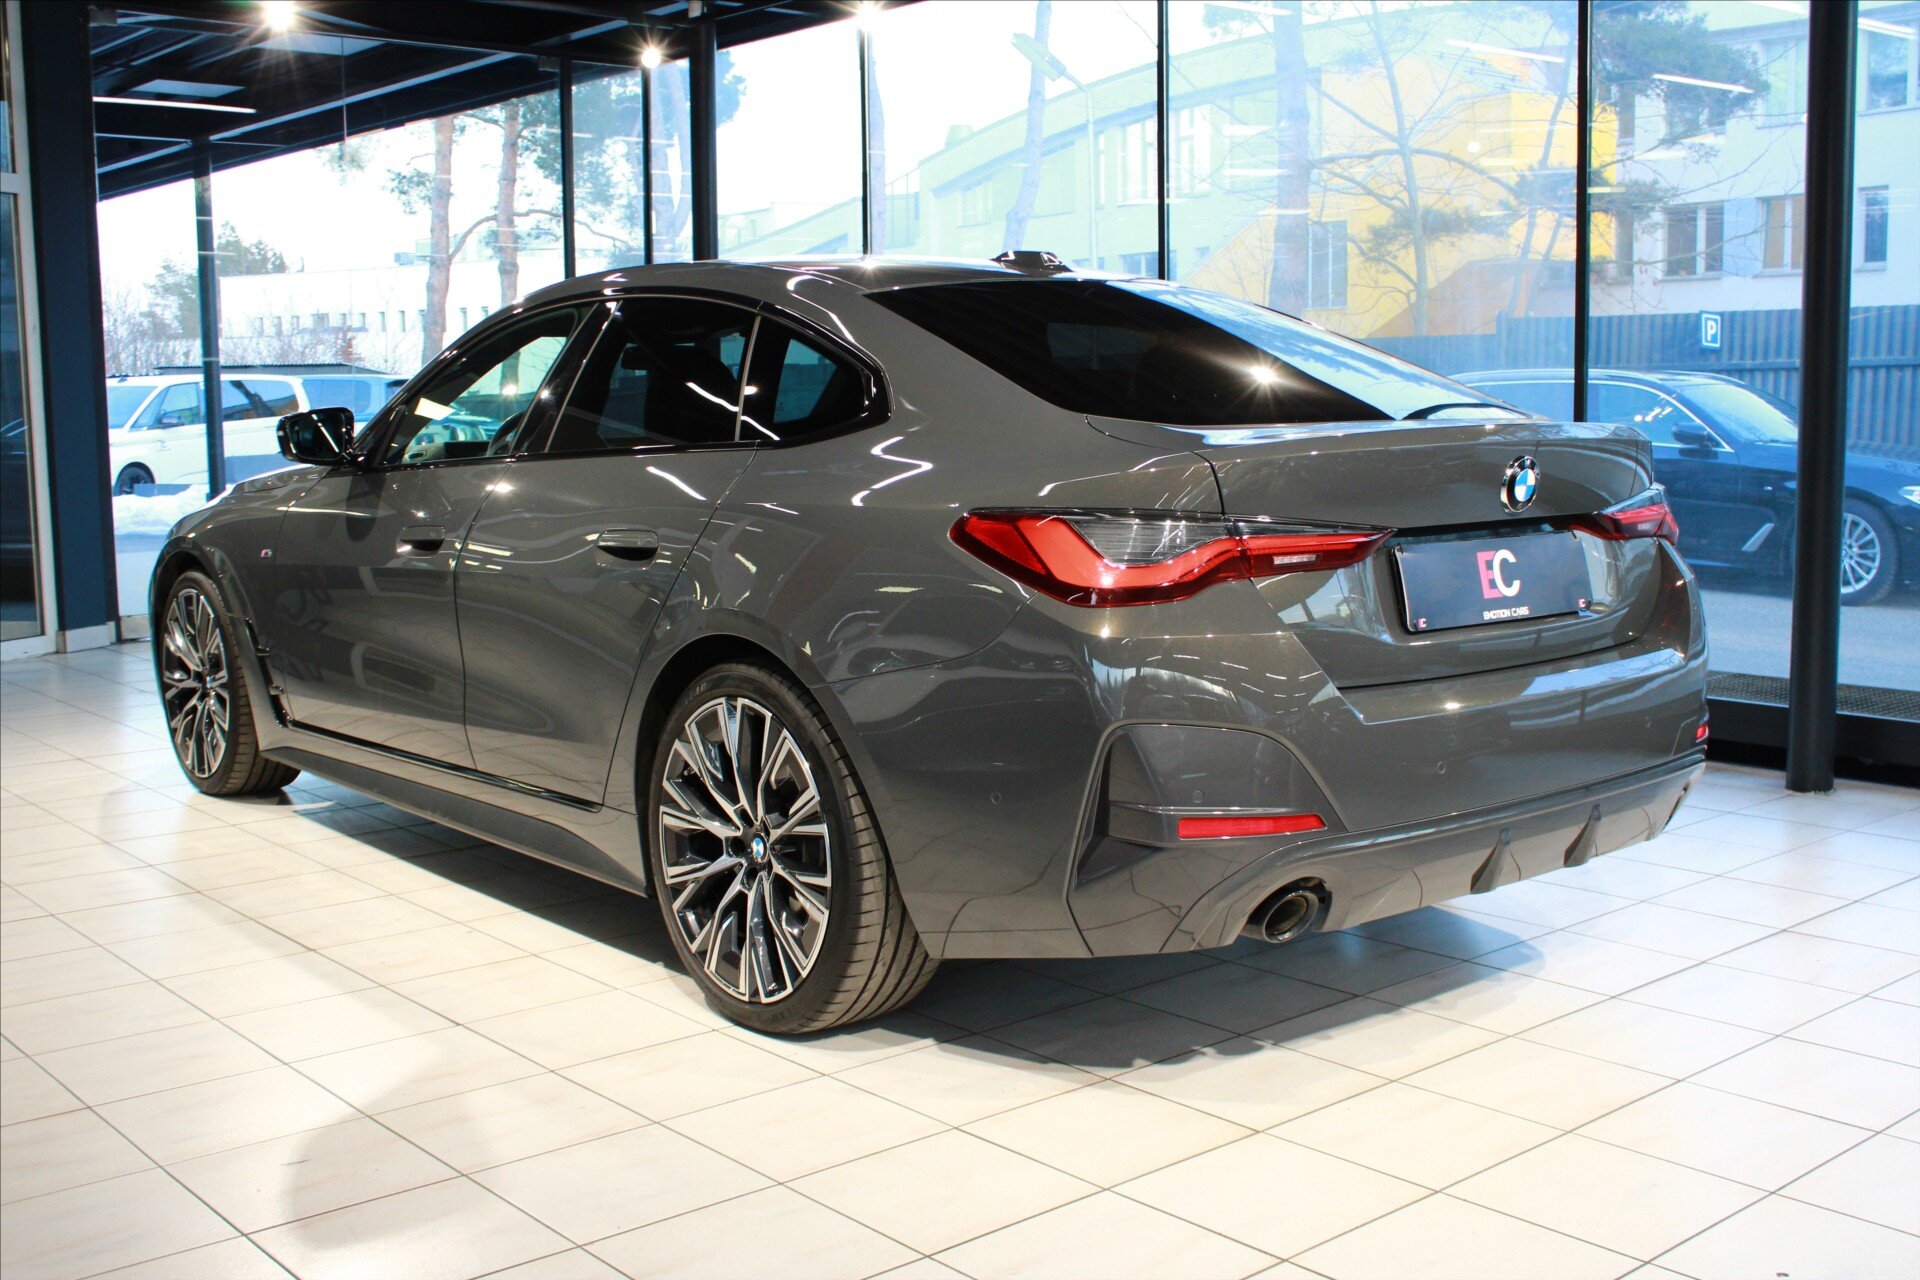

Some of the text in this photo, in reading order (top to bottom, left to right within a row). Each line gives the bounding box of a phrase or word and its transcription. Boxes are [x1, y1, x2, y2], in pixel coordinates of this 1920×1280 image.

[1707, 319, 1717, 341] P
[1476, 549, 1521, 599] EC
[1483, 606, 1530, 620] EMOTION CARS
